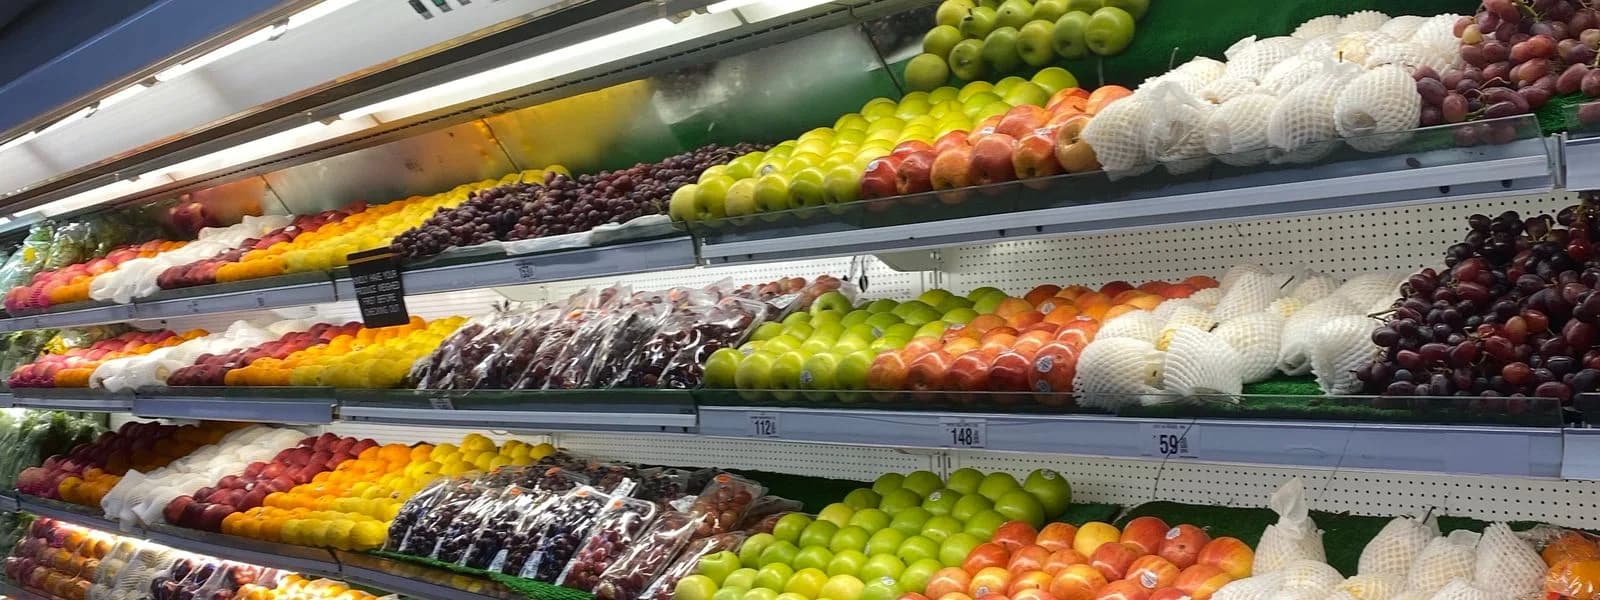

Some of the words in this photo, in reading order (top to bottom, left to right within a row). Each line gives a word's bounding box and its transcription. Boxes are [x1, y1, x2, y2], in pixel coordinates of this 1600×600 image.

[754, 420, 771, 435] 112
[951, 427, 972, 446] 148
[1160, 434, 1178, 454] 59
